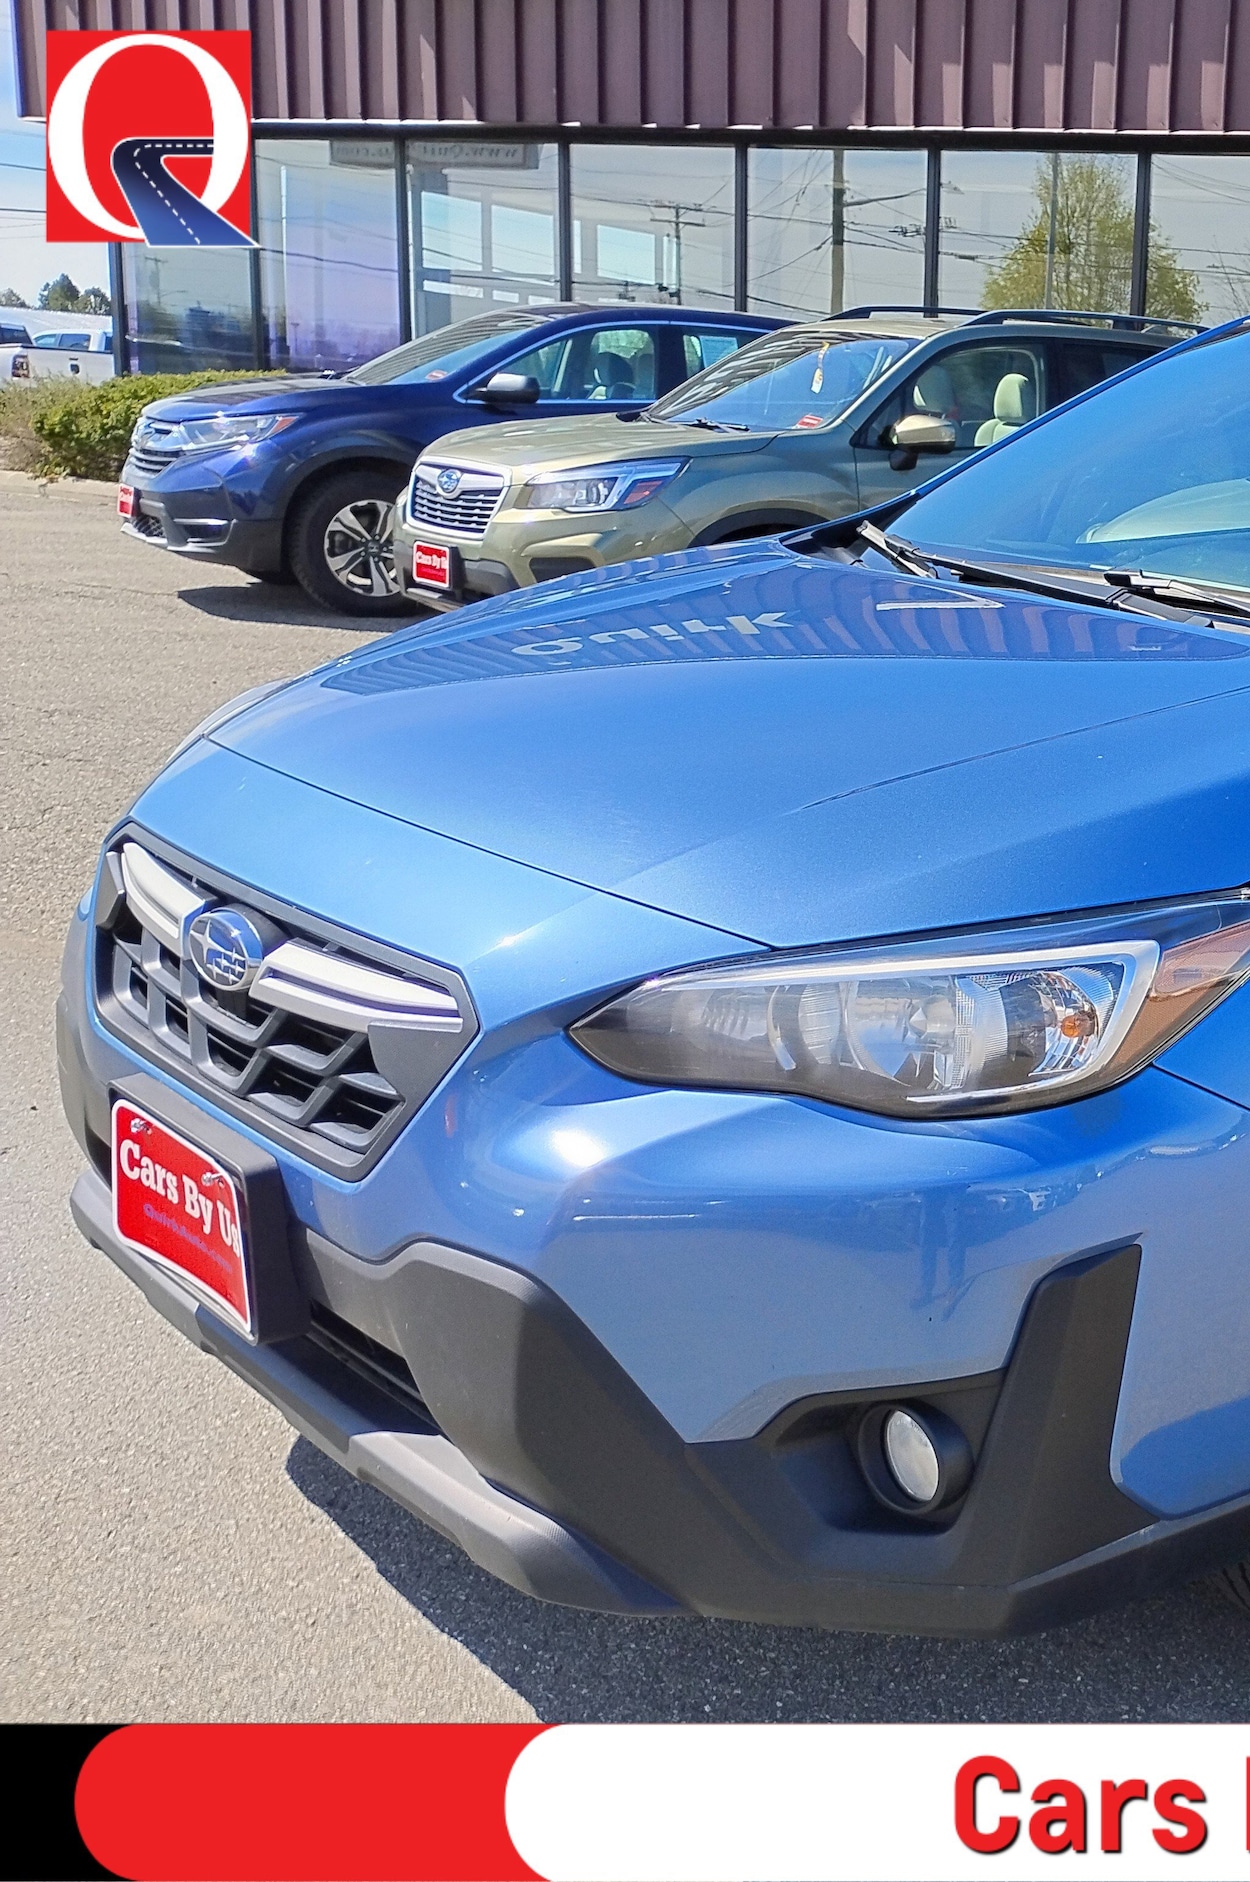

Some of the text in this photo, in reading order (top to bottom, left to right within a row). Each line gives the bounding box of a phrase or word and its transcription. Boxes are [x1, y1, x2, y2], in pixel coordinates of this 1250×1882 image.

[119, 1138, 240, 1258] Cars By Us
